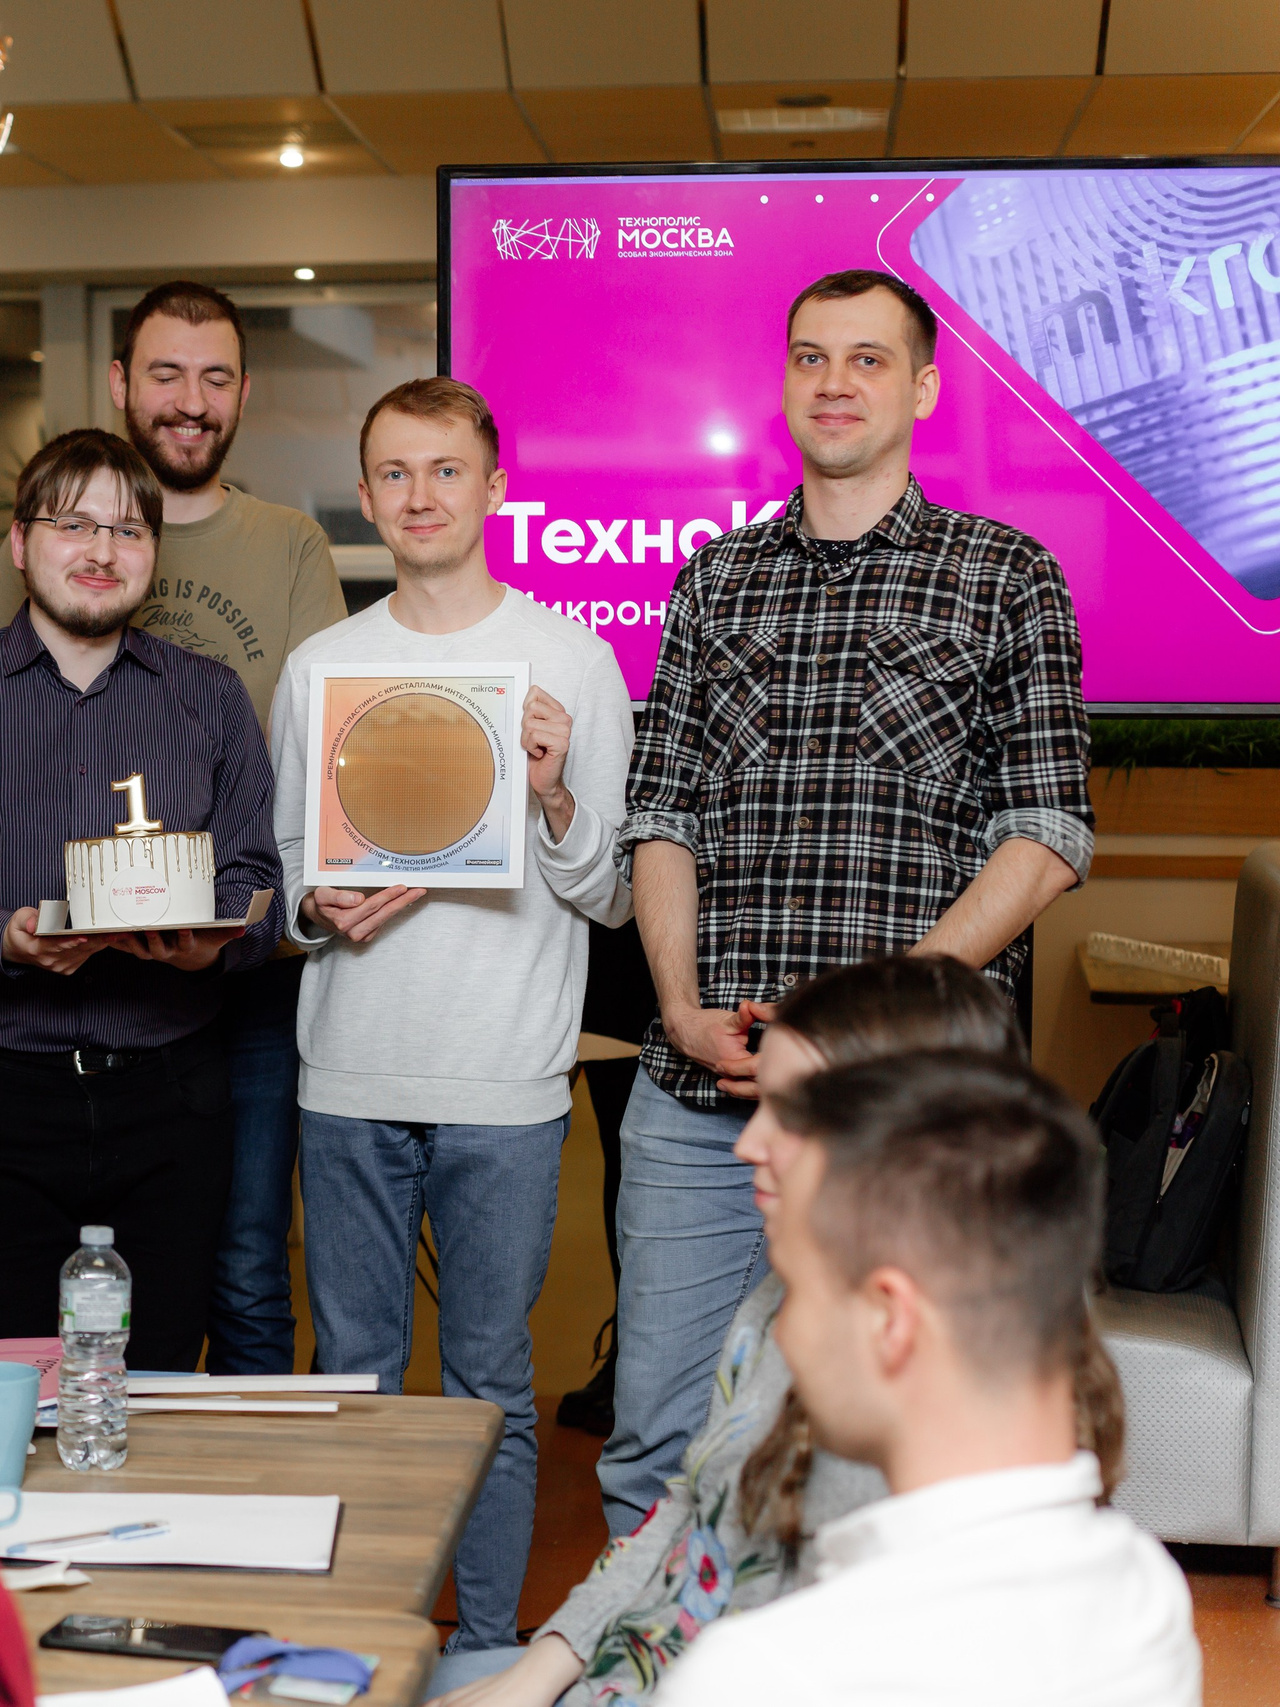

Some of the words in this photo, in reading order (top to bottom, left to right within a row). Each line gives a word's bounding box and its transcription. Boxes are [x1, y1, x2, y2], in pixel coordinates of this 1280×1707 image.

[618, 217, 701, 227] ТЕХНОПОЛИС
[617, 227, 735, 249] МОСКВА
[648, 250, 712, 258] ЭКОНОМИЧЕСКАЯ
[714, 249, 734, 257] ЗОНА
[142, 604, 194, 628] Basic
[175, 579, 194, 599] IS
[196, 585, 265, 662] POSSIBLE
[327, 727, 346, 780] КРЕМНИЕВАЯ
[343, 695, 377, 728] ПЛАСТИНА
[384, 682, 443, 694] КРИСТАЛЛАМИ
[444, 686, 494, 730] ИНТЕГРАЛЬНЫХ
[491, 730, 506, 780] МИКРОСХЕМ
[111, 772, 163, 835] 1
[341, 822, 389, 860] ПОБЕДИТЕЛЯМ
[391, 856, 442, 866] ТЕХНОКВИЗА
[442, 822, 488, 860] МИКРОНУМ55
[135, 887, 166, 895] MOSCOW
